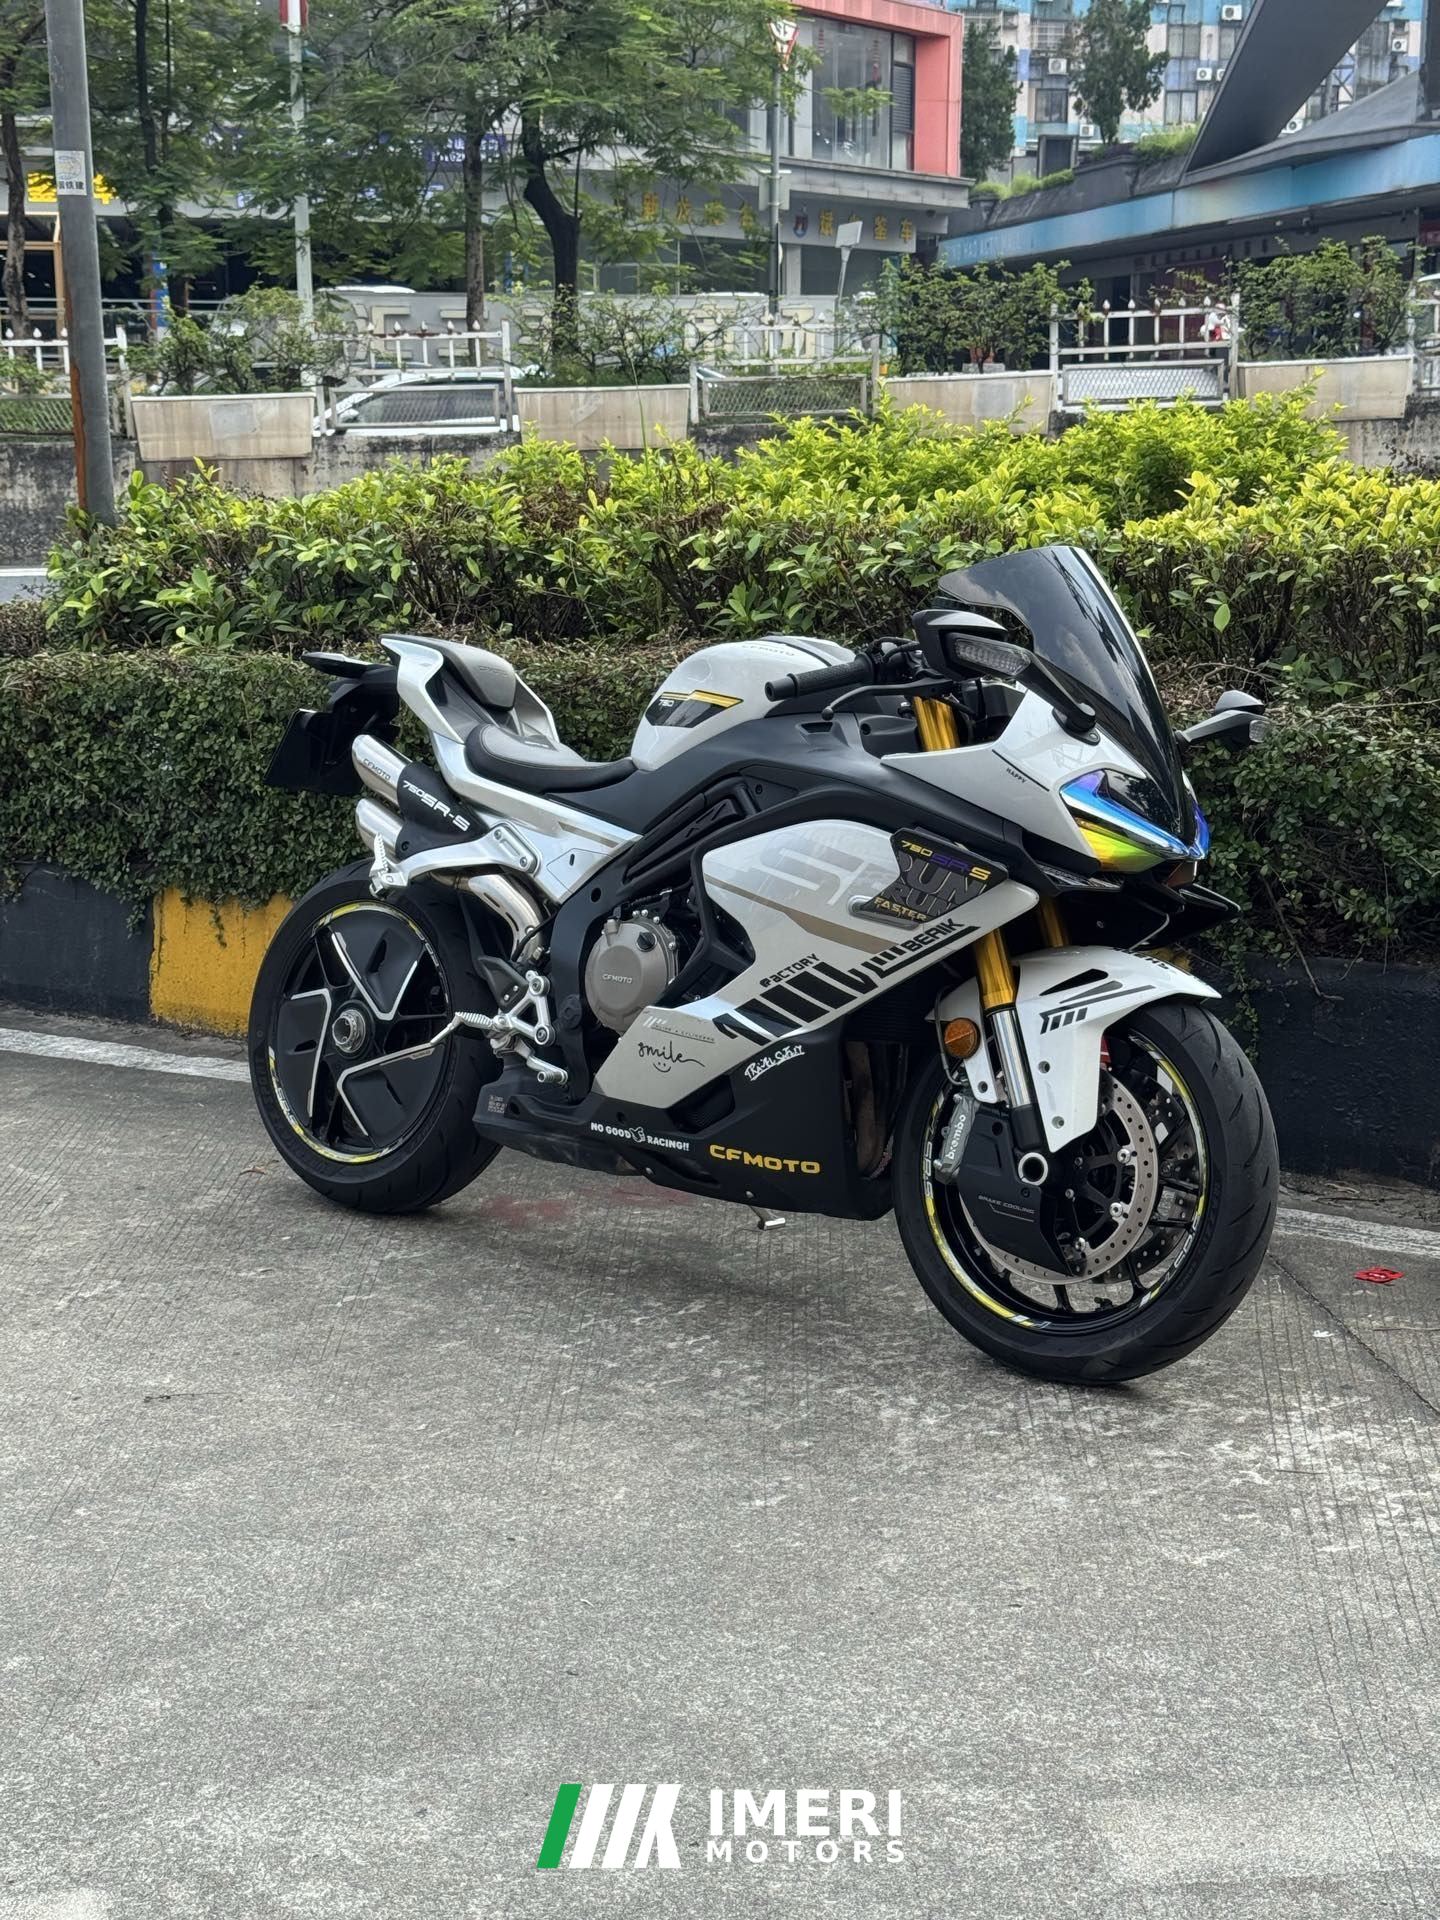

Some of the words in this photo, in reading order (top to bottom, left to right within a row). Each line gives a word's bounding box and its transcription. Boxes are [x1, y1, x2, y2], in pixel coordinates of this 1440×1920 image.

[363, 758, 391, 780] CFMOTO
[874, 897, 927, 921] FASTER
[601, 973, 633, 984] CFMOTO
[590, 1122, 604, 1133] NO
[605, 1126, 632, 1139] GOOD
[646, 1135, 690, 1152] RACING!!
[945, 1114, 966, 1160] brembo
[709, 1144, 821, 1175] CFMOTO
